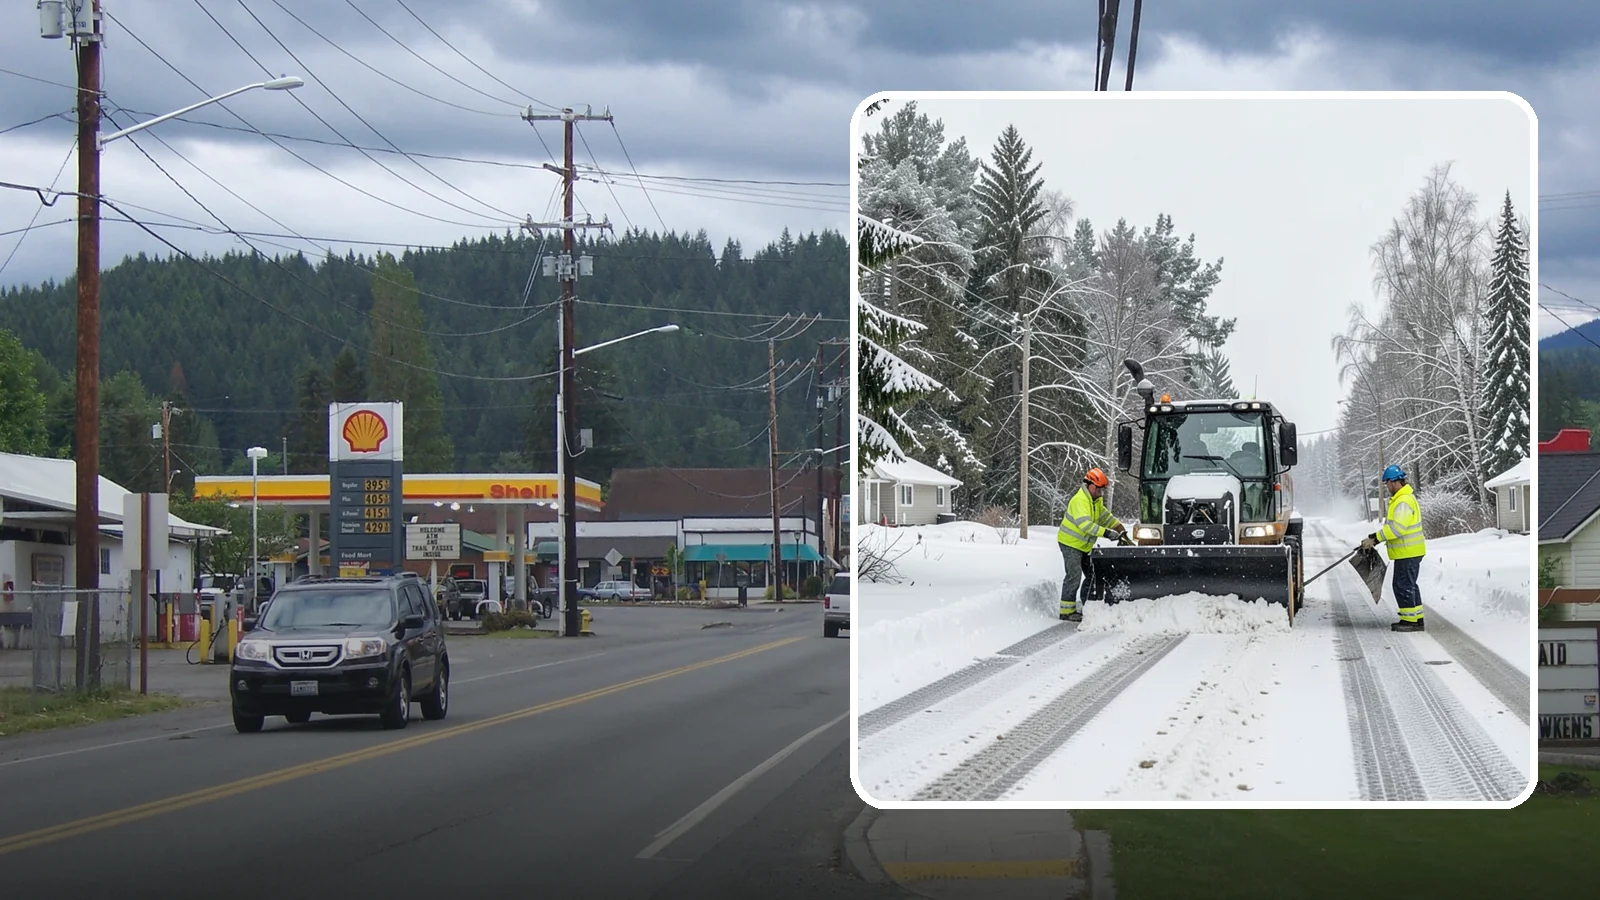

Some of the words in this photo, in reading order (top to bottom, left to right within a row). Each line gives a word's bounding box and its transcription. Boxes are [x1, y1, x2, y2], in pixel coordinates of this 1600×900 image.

[365, 480, 384, 490] 395
[489, 484, 548, 499] Shell
[365, 494, 384, 504] 405
[365, 508, 384, 518] 415
[365, 522, 384, 532] 429
[1538, 643, 1567, 666] AID
